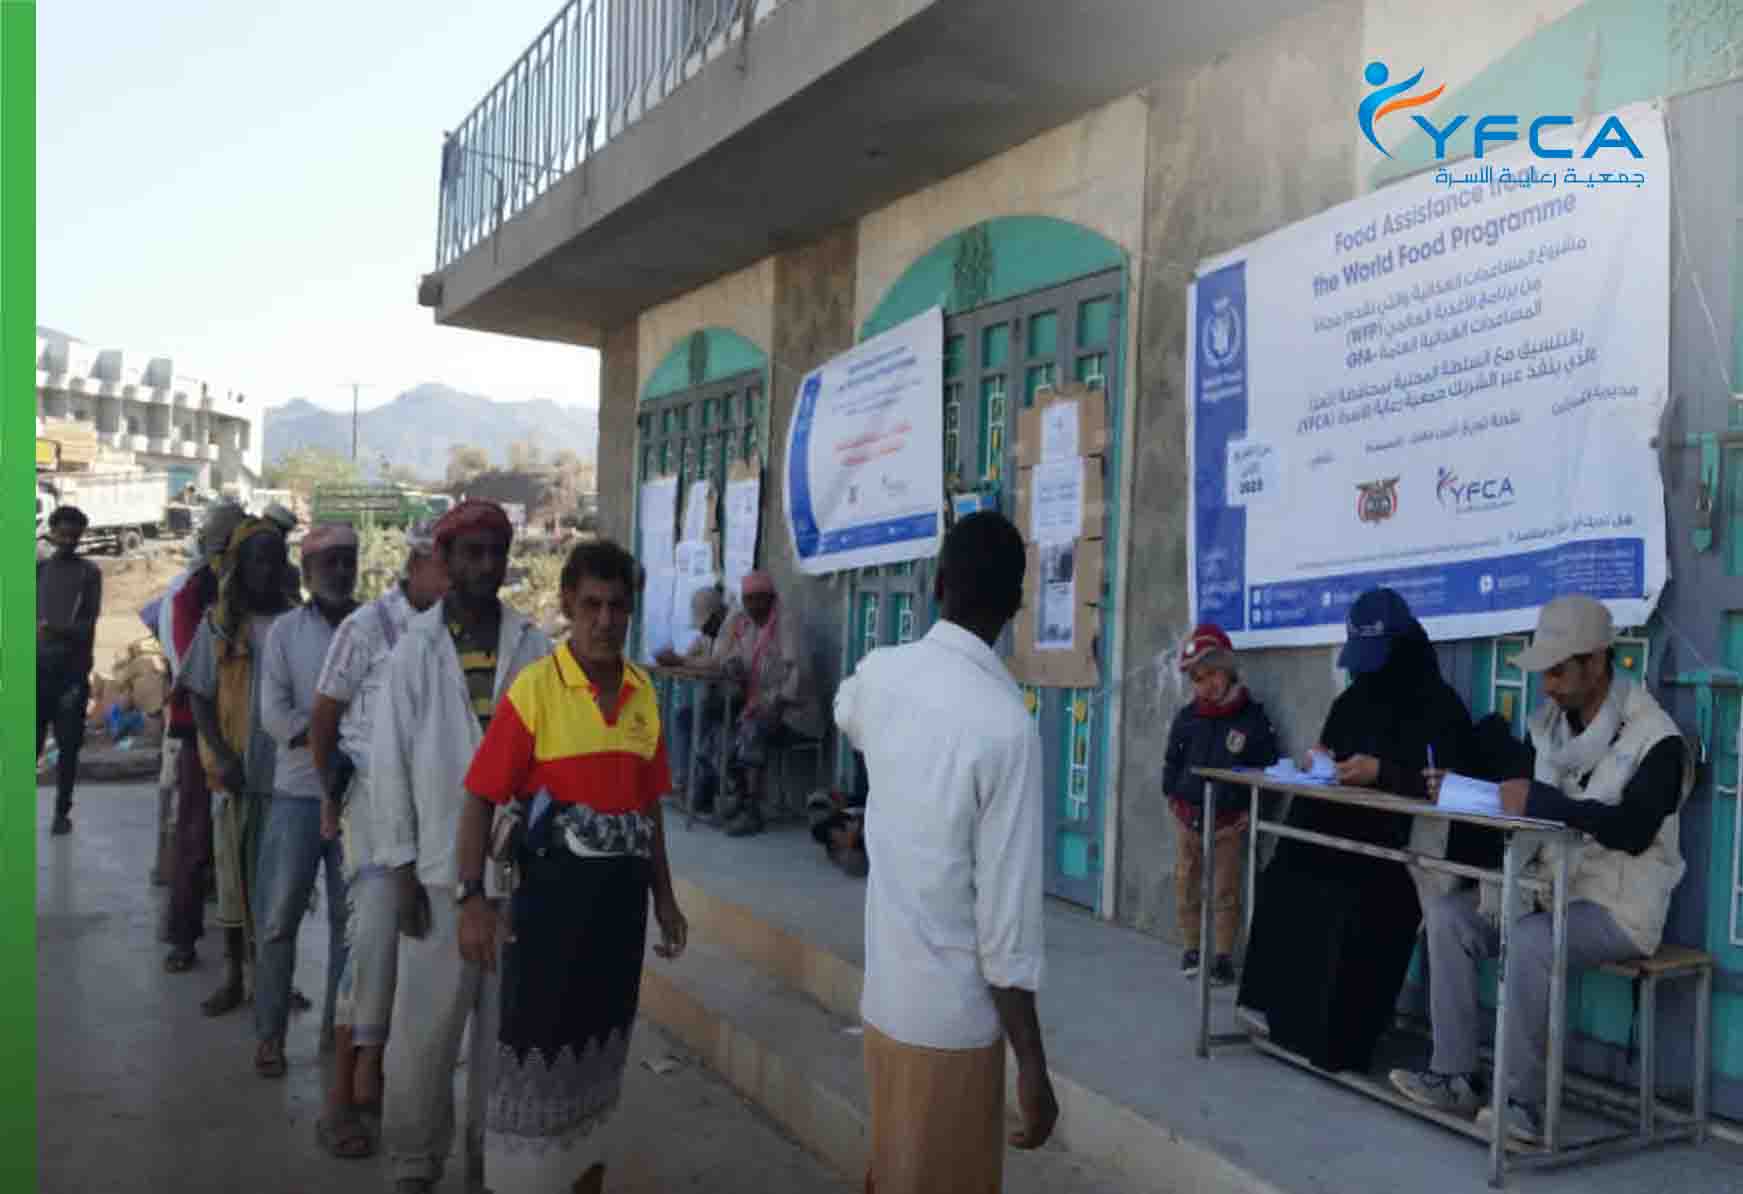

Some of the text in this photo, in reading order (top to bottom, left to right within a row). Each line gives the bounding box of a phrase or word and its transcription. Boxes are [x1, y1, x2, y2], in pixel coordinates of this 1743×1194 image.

[1312, 191, 1576, 298] the World Food Programme
[1335, 220, 1377, 255] Food
[1383, 184, 1484, 236] Assistance
[1450, 477, 1514, 505] YFCA
